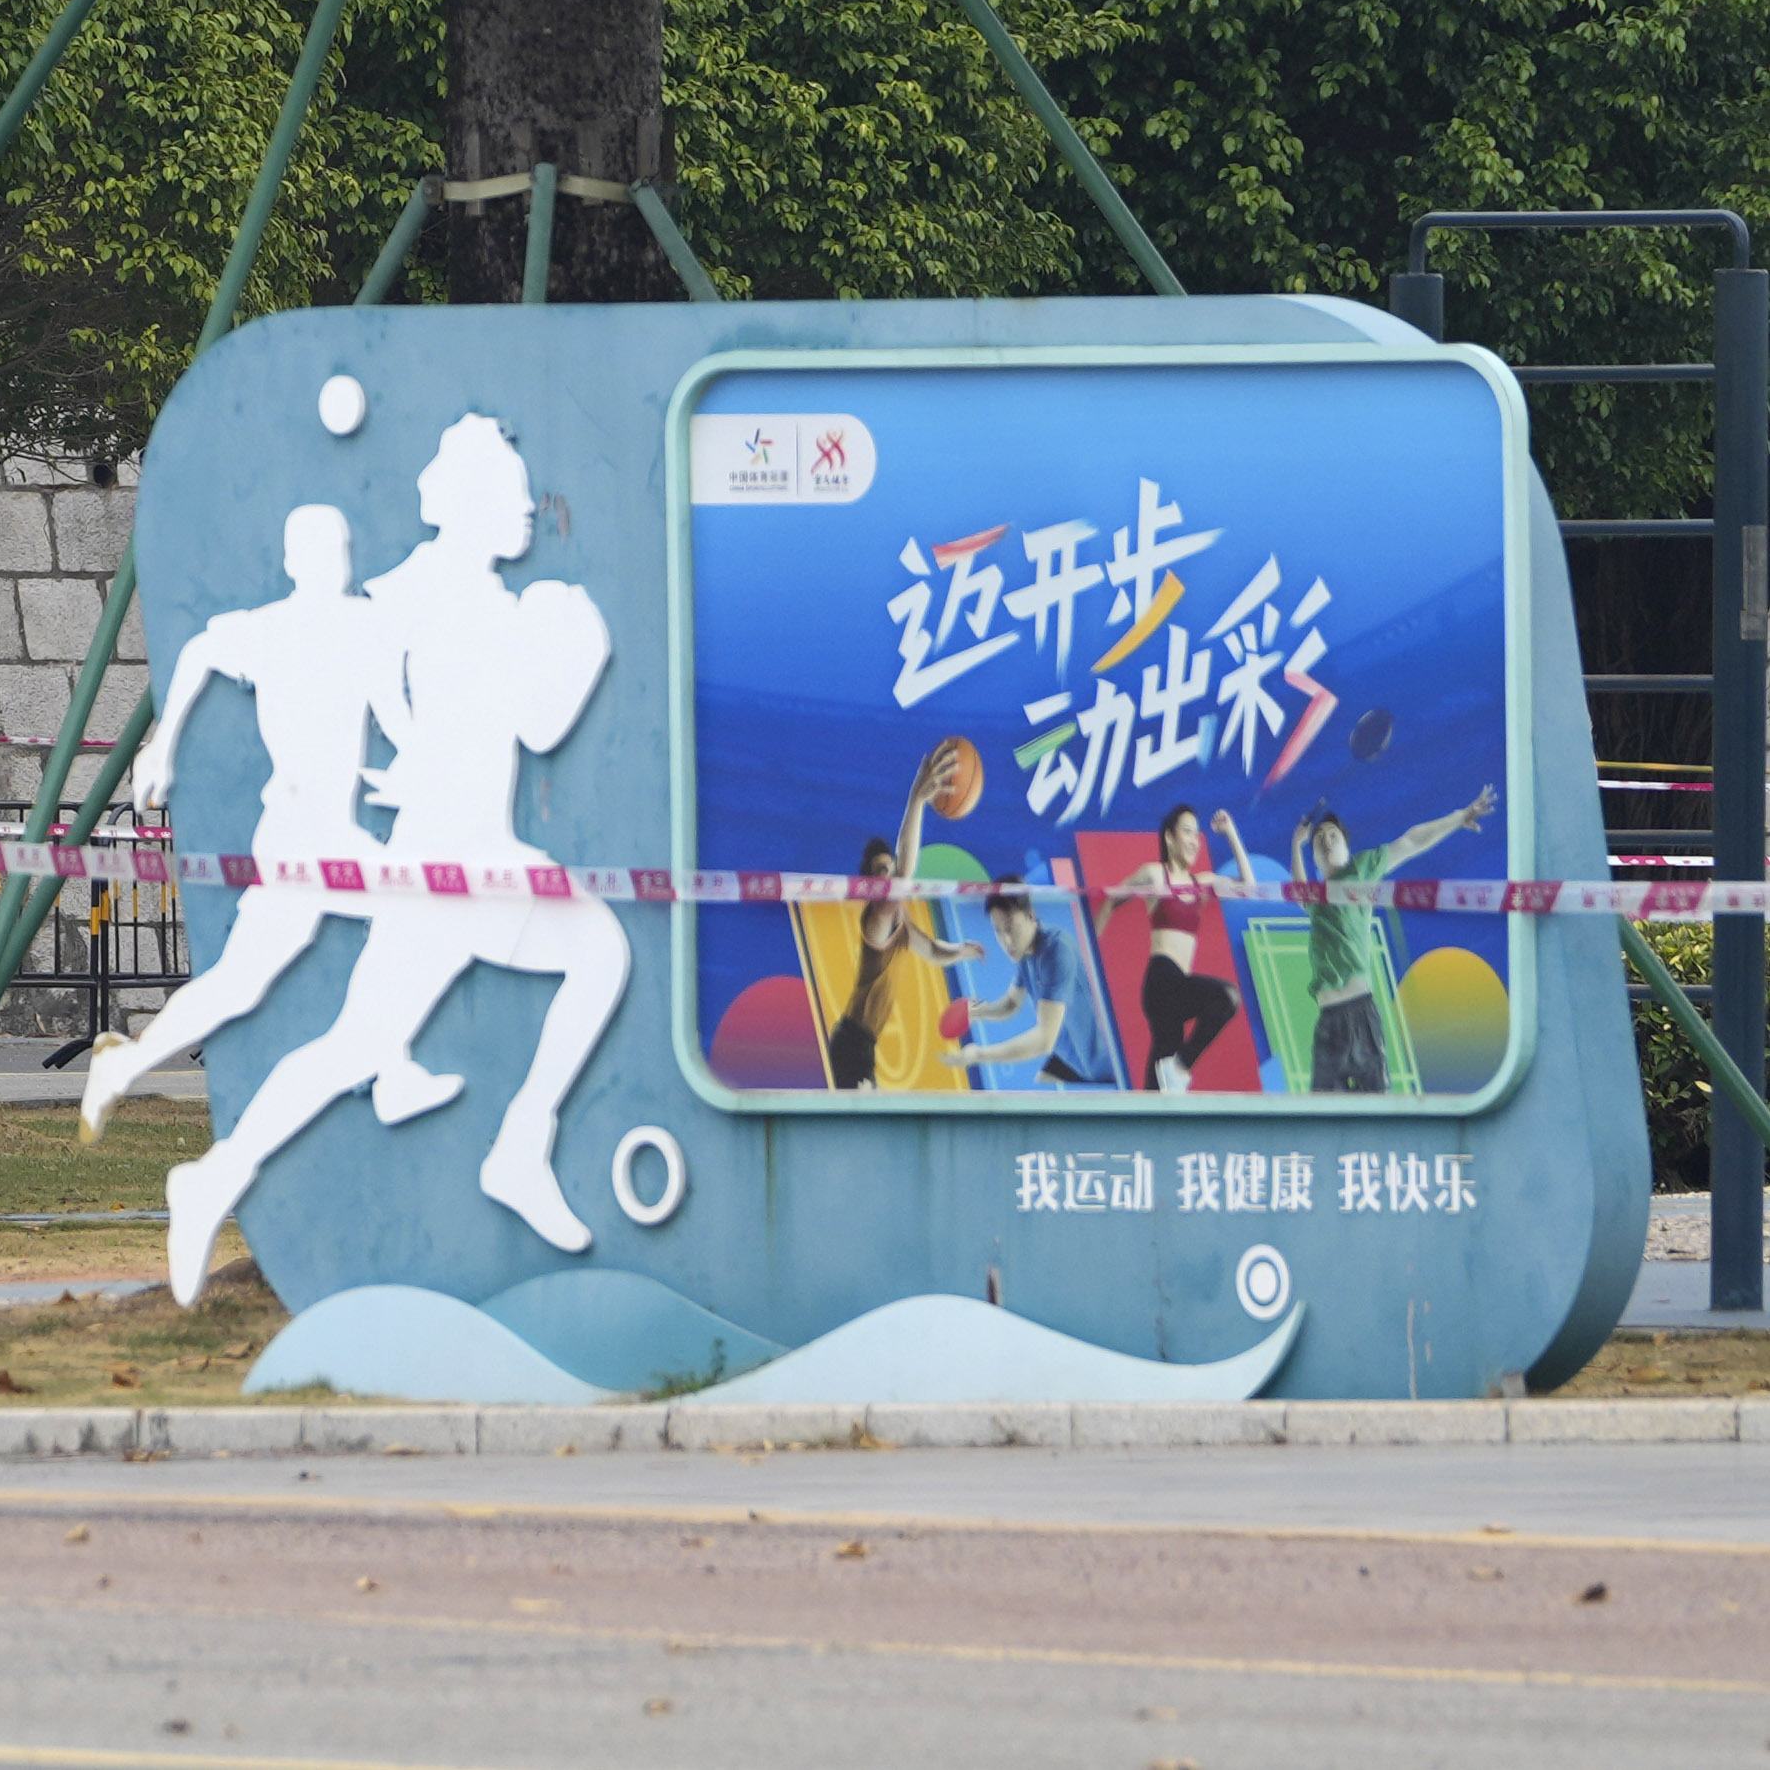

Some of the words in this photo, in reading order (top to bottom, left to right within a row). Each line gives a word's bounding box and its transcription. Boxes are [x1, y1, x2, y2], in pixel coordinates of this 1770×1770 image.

[886, 476, 1226, 710] 迈开步
[1012, 552, 1338, 828] 动出彩
[1015, 1150, 1155, 1212] 我运动
[1176, 1150, 1315, 1212] 我健康
[1337, 1150, 1477, 1213] 我快乐
